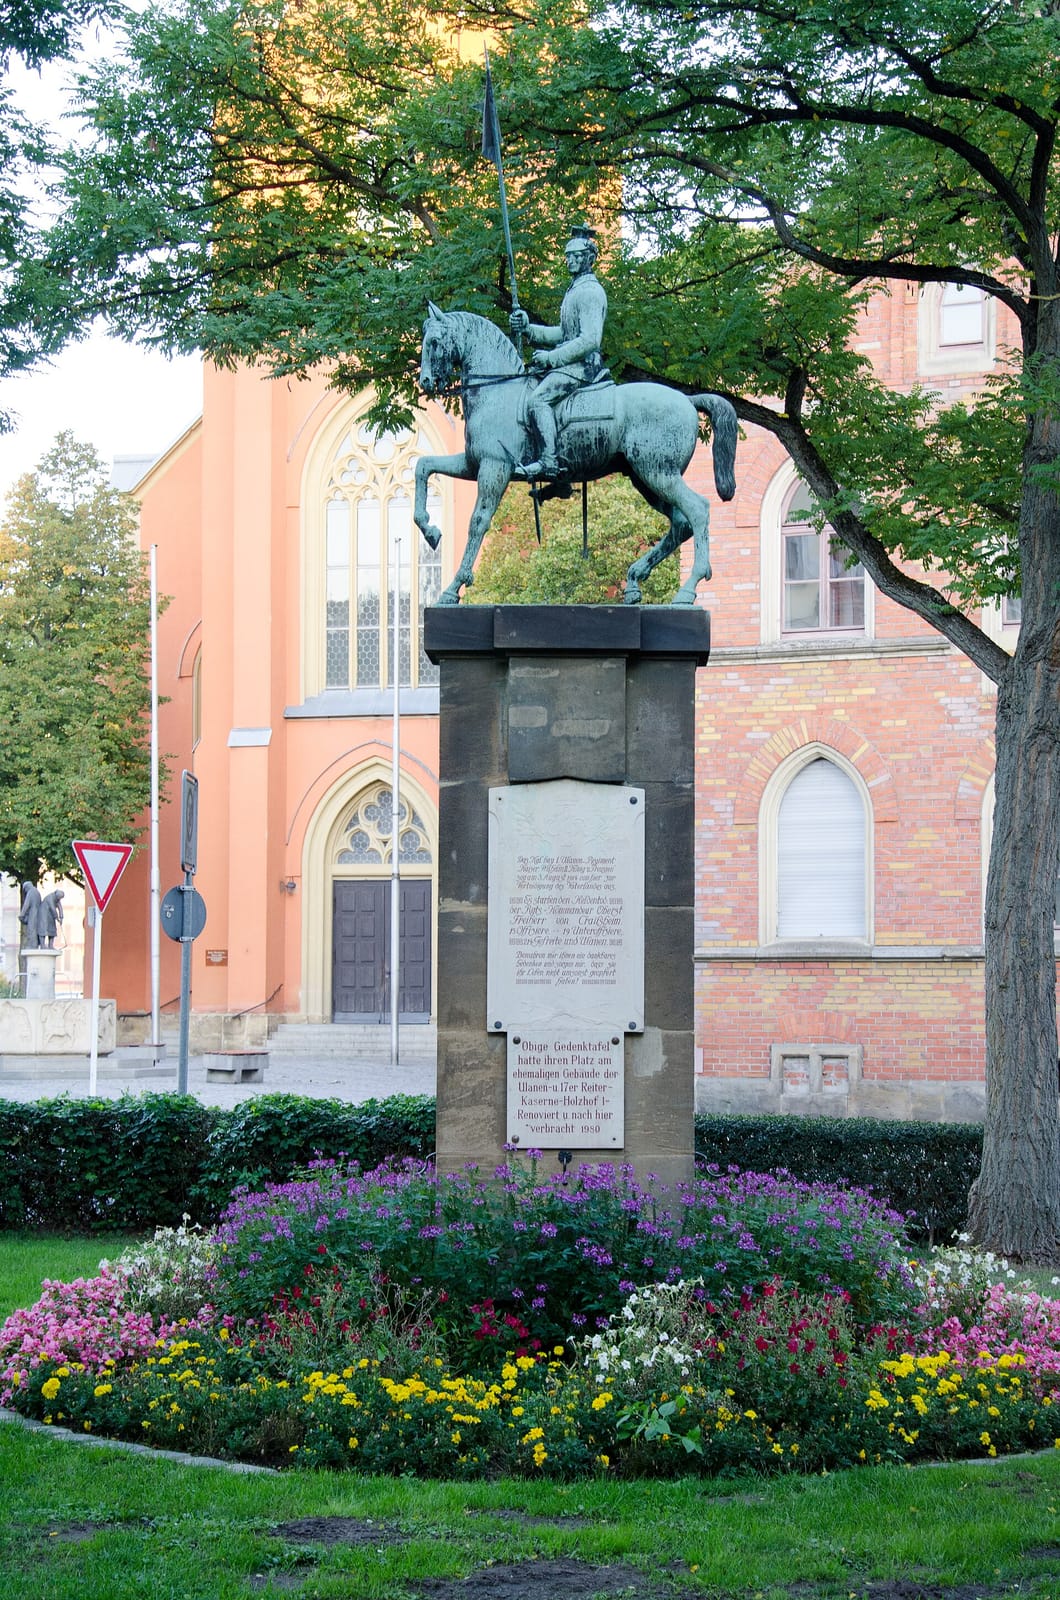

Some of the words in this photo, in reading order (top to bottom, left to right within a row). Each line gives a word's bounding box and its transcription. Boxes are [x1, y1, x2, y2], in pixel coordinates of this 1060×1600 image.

[522, 1041, 548, 1053] Obige
[554, 1041, 610, 1051] Gedenktafel
[518, 1055, 541, 1064] hatte
[544, 1055, 568, 1064] ihren
[572, 1055, 594, 1064] Platz
[513, 1069, 559, 1080] ehemaligen
[563, 1069, 600, 1078] Gebäude
[604, 1069, 618, 1078] der
[581, 1082, 612, 1092] Reiter-
[521, 1096, 598, 1106] Kaserne-Holzhof
[517, 1110, 559, 1120] Renoviert
[572, 1110, 592, 1120] nach
[595, 1110, 613, 1120] hier
[530, 1123, 575, 1133] verbracht
[581, 1125, 600, 1133] 1980
